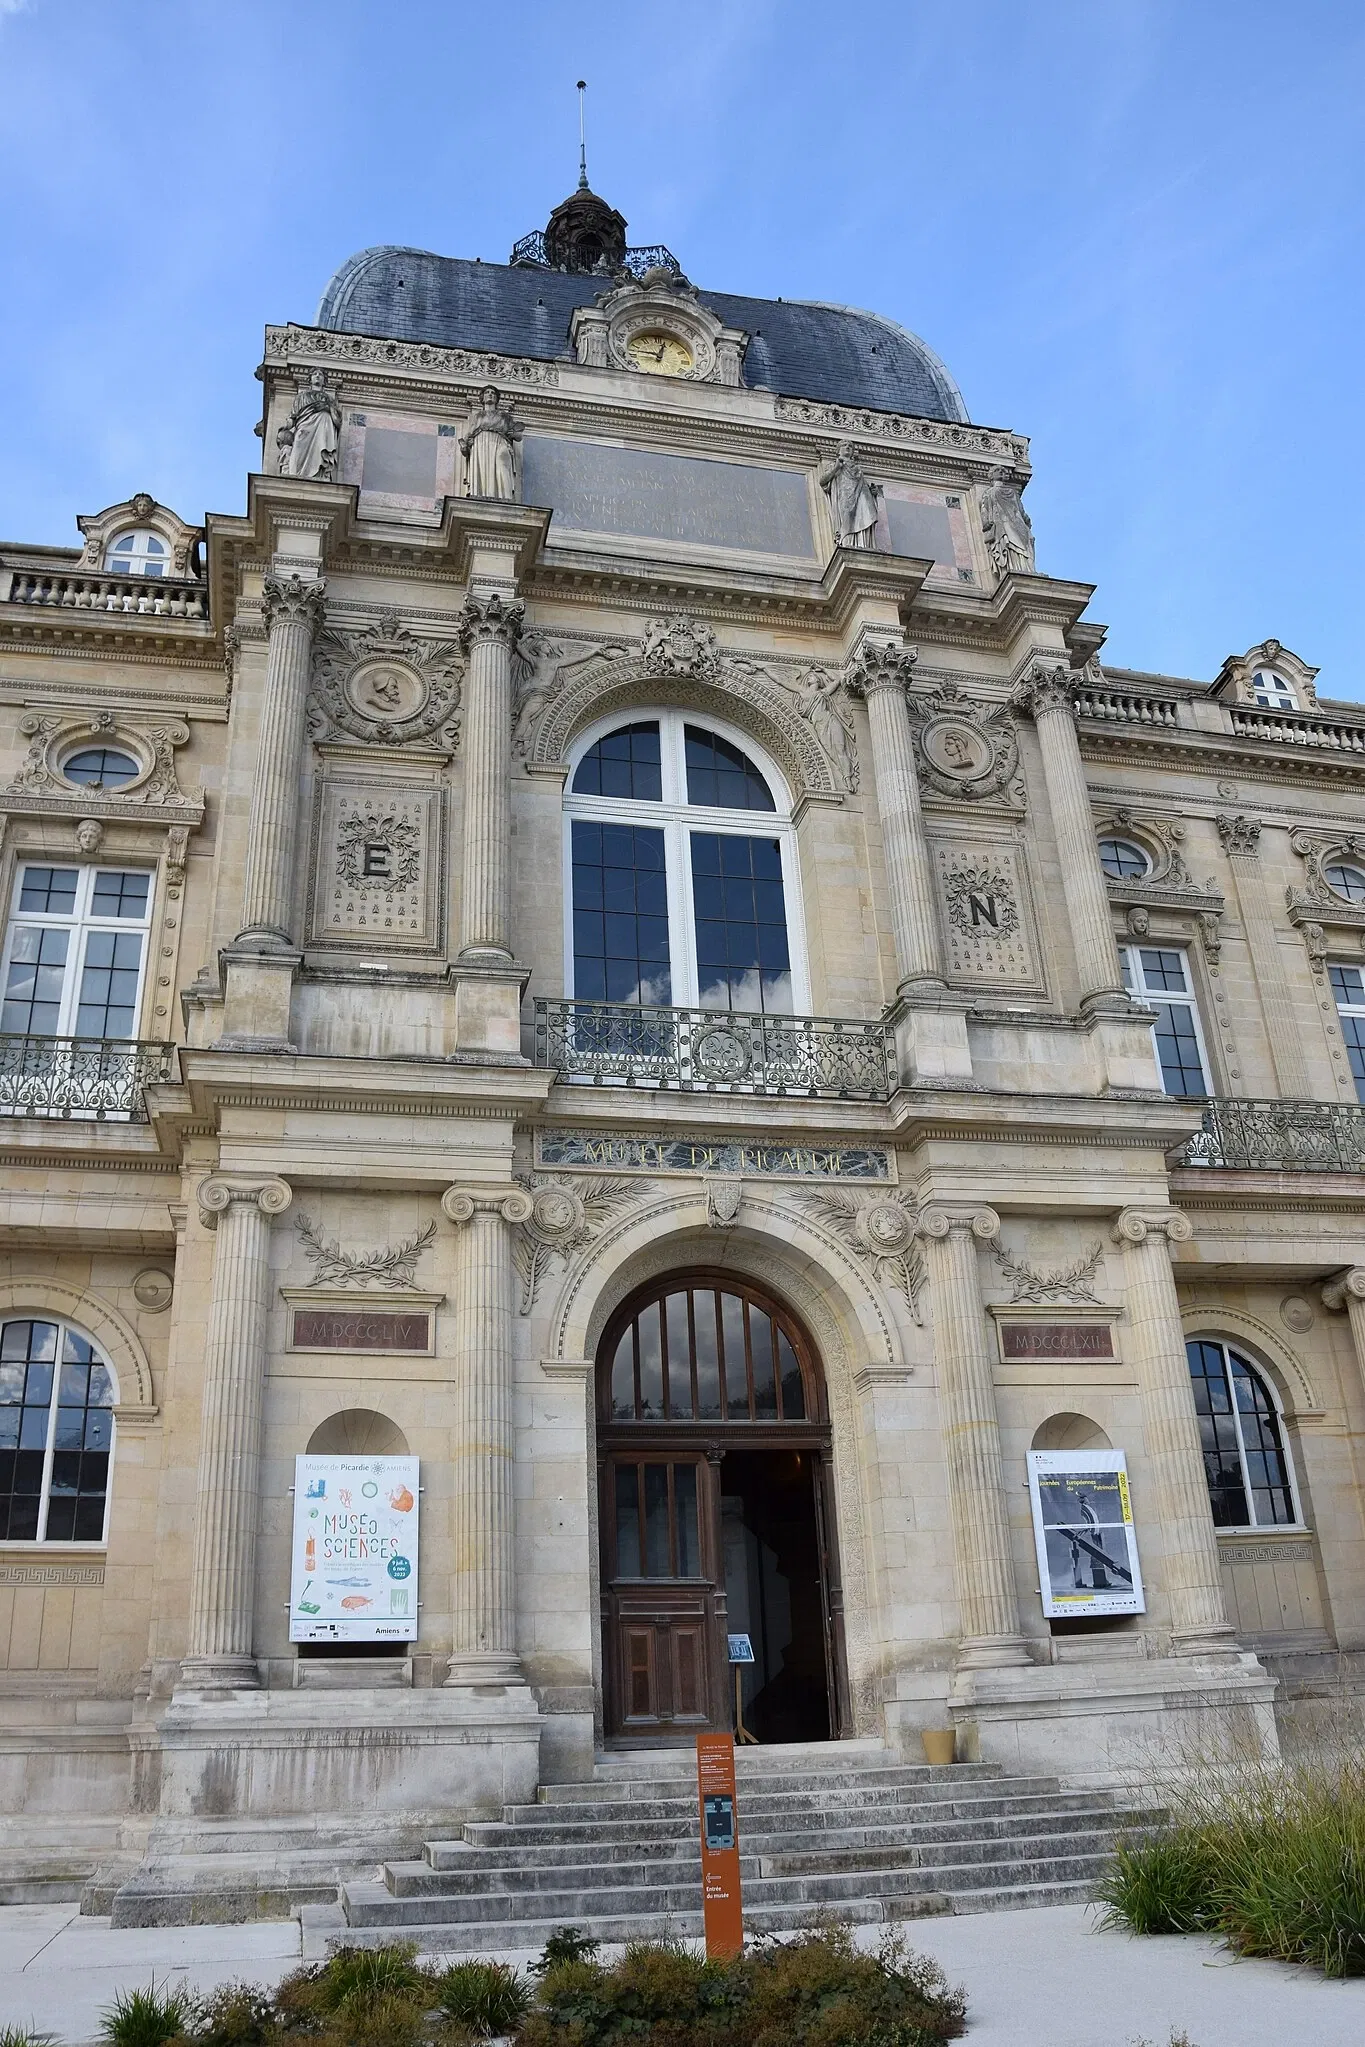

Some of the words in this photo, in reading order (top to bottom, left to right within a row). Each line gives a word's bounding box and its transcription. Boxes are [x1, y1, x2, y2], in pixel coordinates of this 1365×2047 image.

[363, 843, 391, 877] E
[969, 894, 998, 927] N
[330, 1463, 339, 1471] de
[340, 1463, 370, 1471] Picardie
[324, 1513, 378, 1535] MUSÉO
[324, 1538, 399, 1559] SCIENCES
